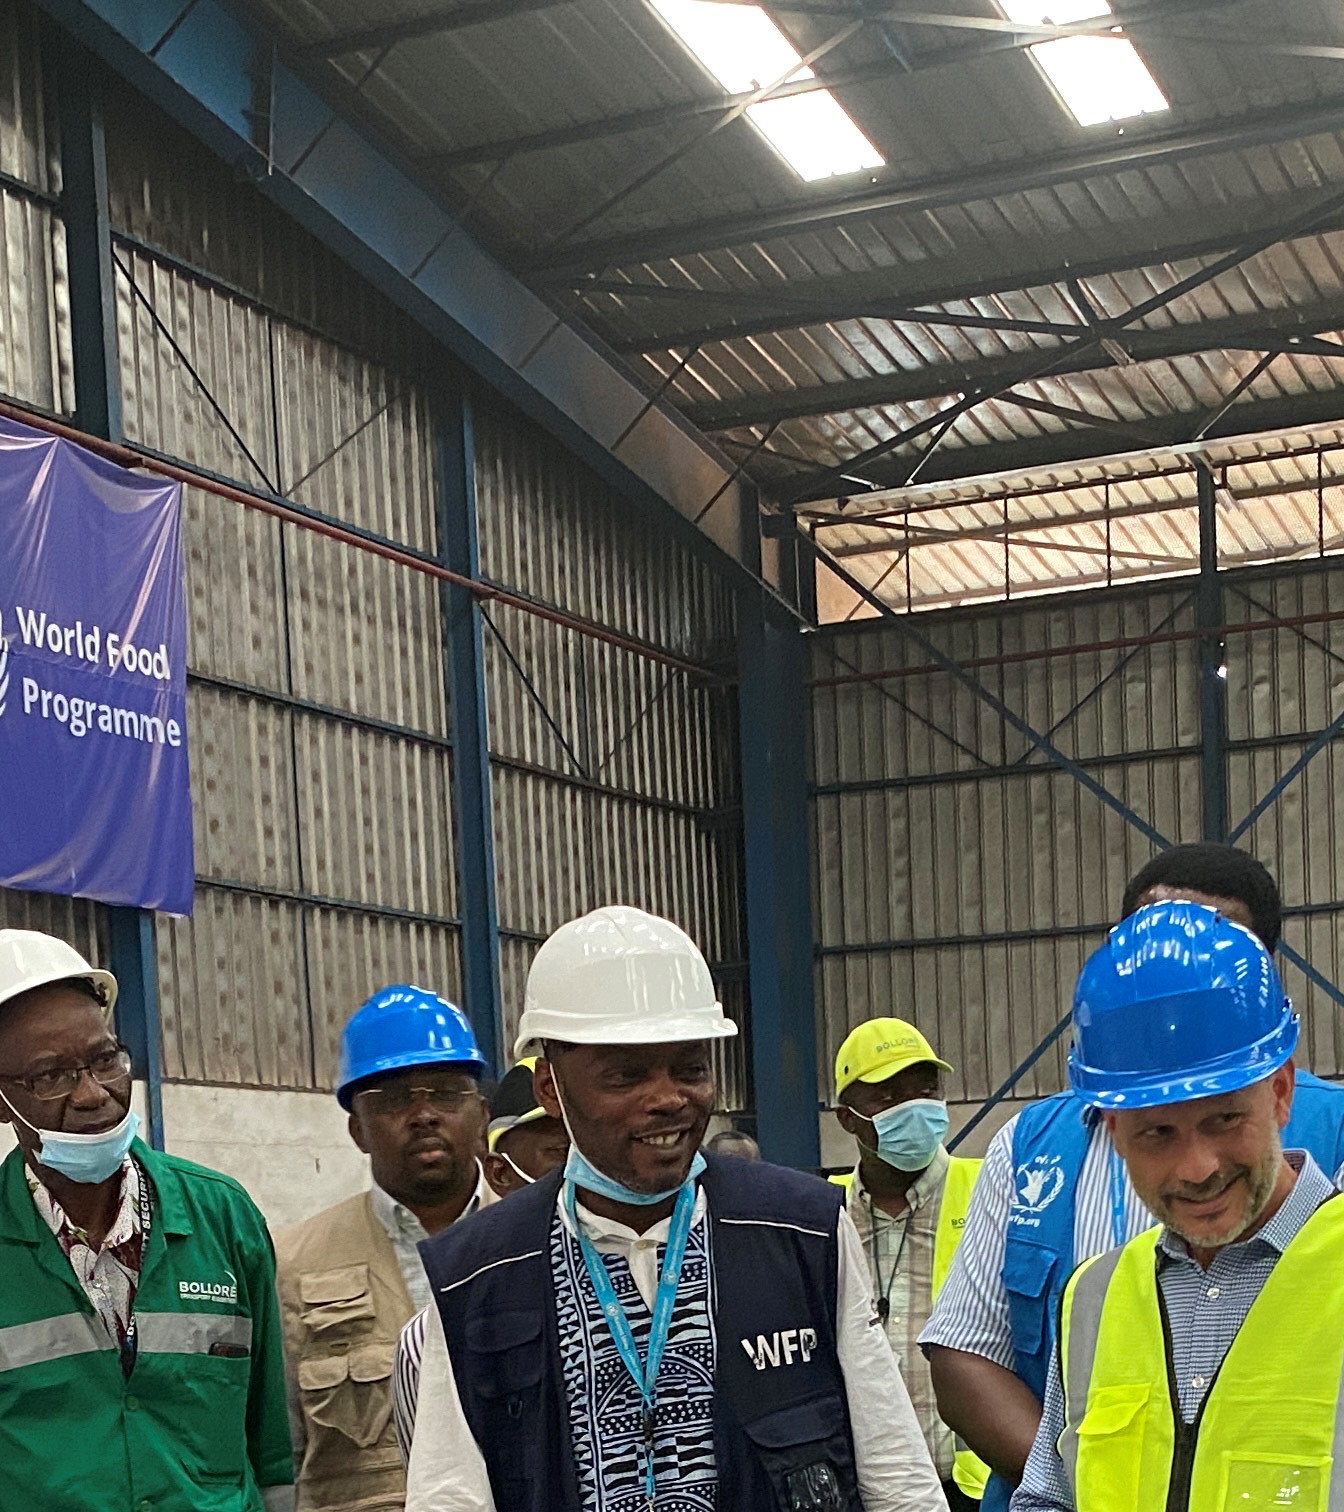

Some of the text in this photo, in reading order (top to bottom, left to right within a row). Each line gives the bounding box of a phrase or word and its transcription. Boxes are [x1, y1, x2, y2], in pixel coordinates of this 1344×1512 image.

[16, 606, 169, 680] World Food
[22, 677, 181, 747] Programme
[741, 1328, 817, 1370] WFP
